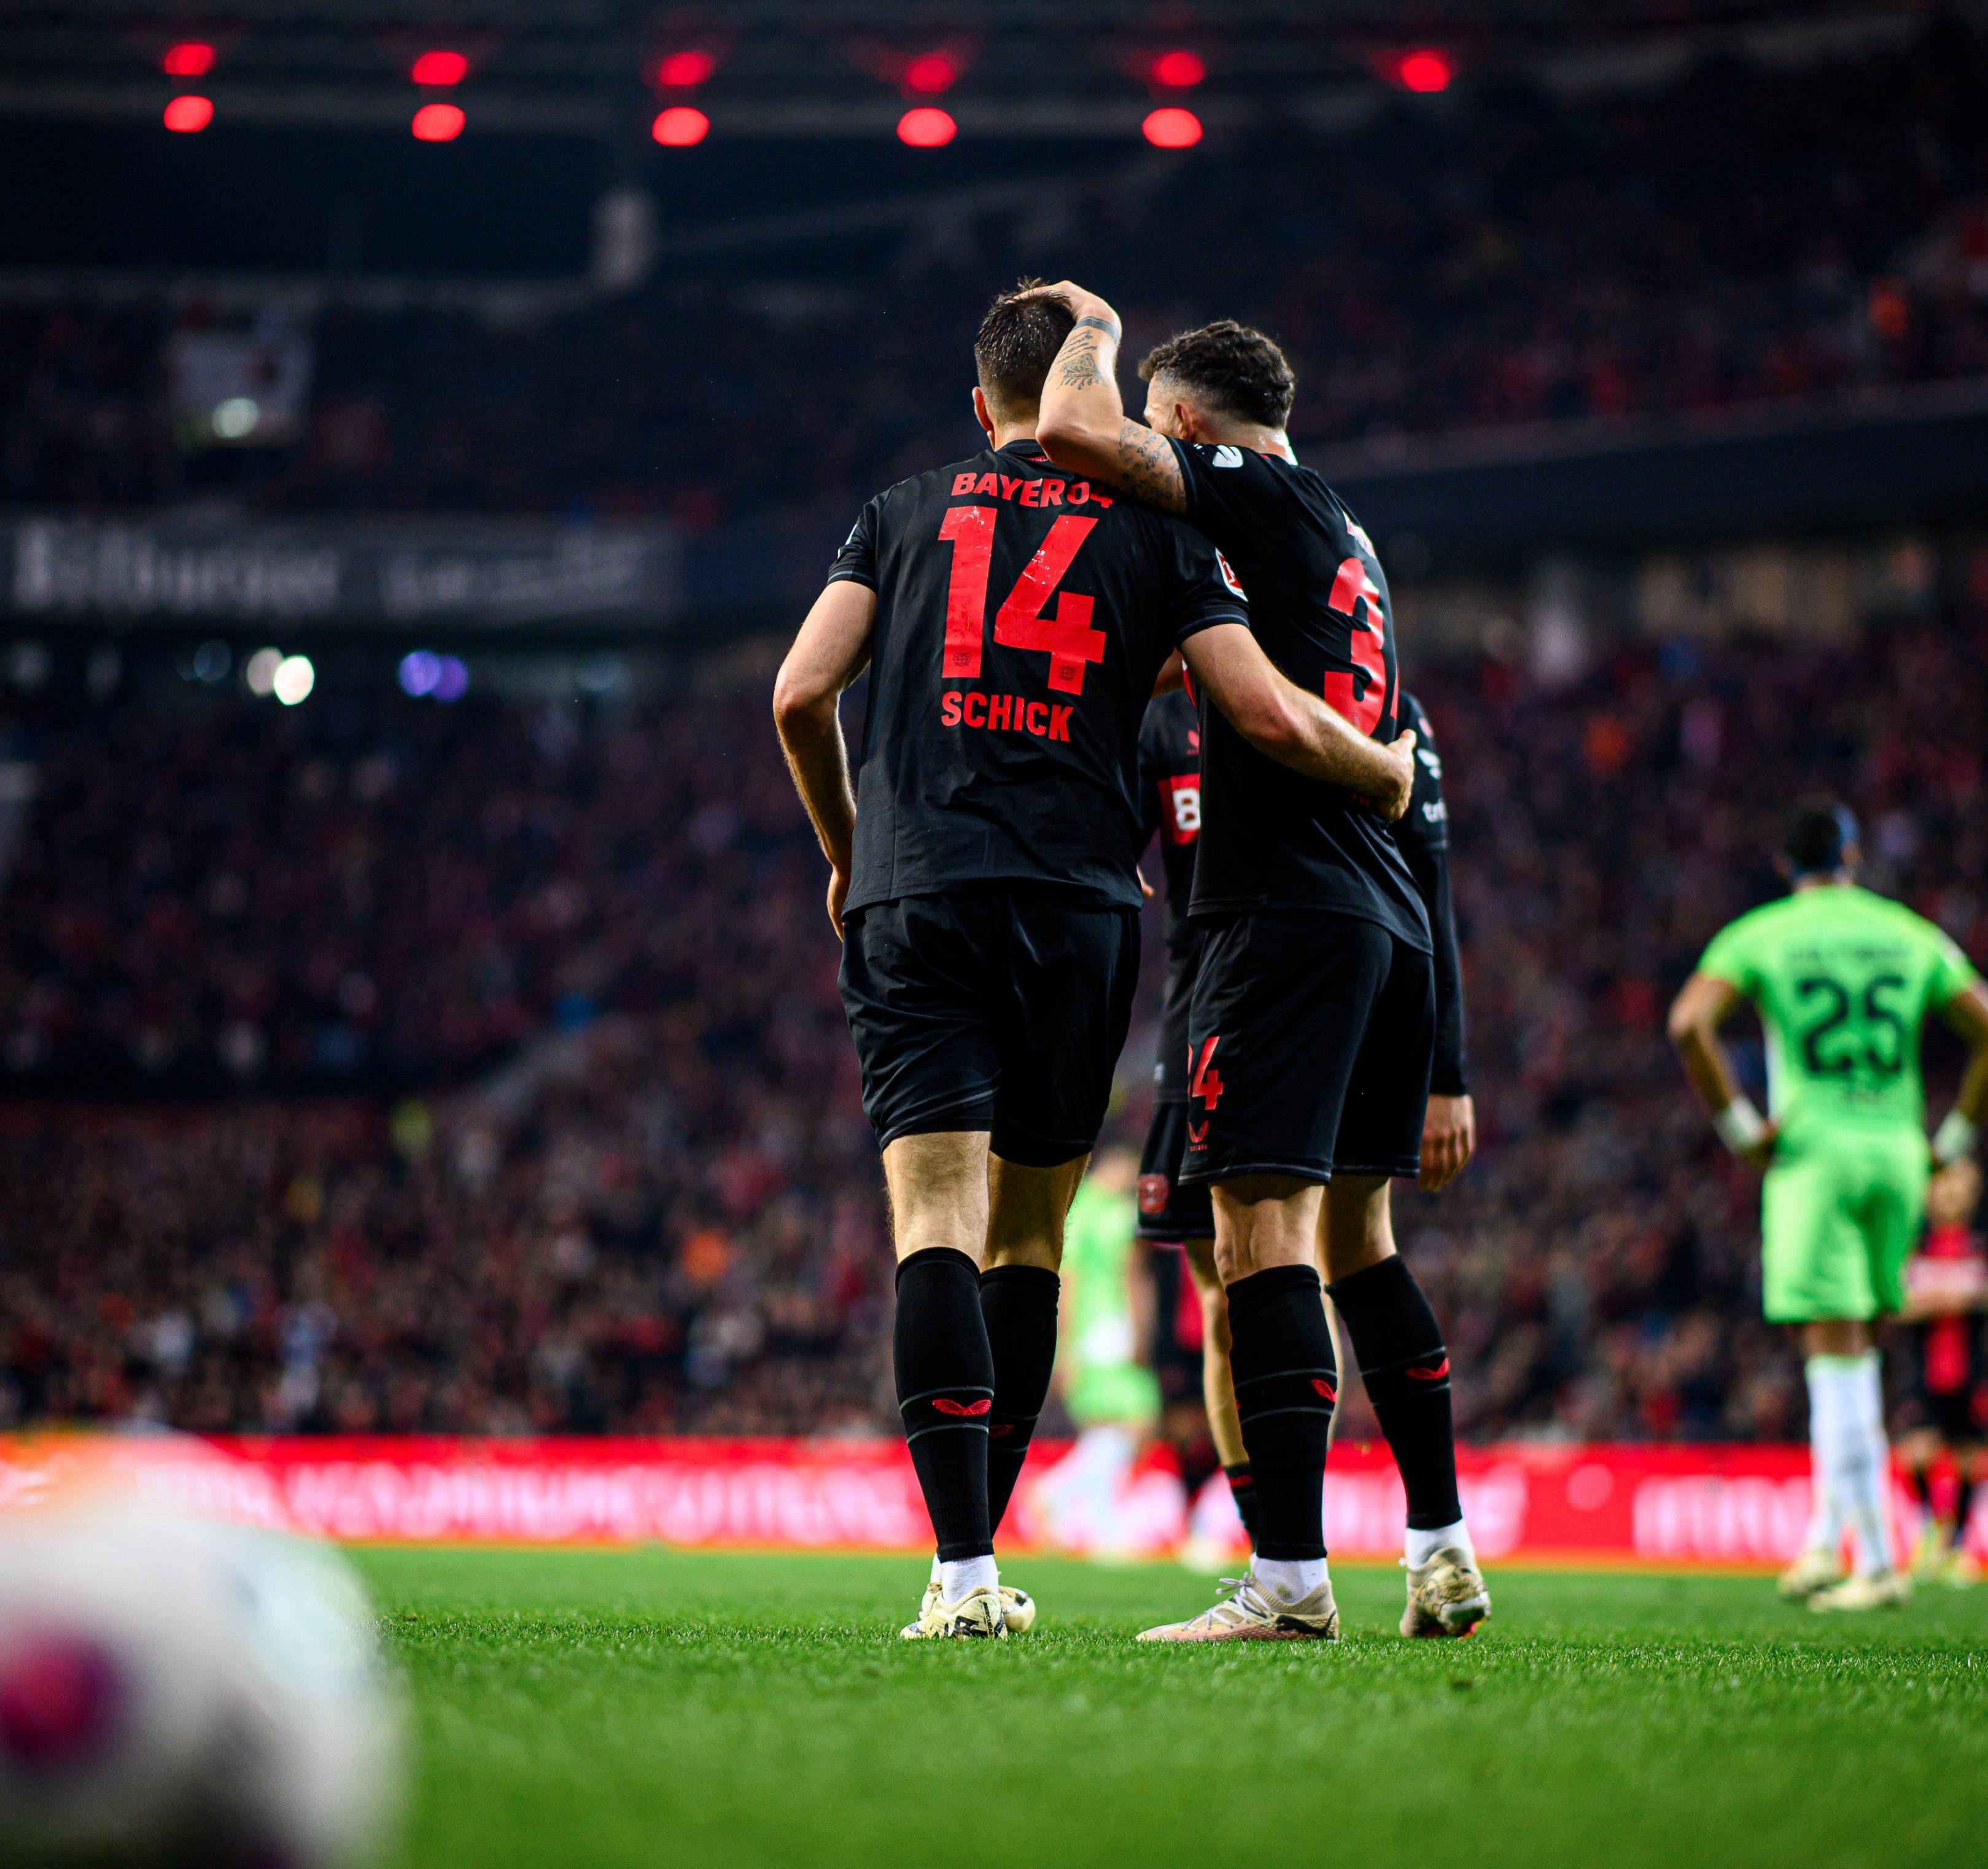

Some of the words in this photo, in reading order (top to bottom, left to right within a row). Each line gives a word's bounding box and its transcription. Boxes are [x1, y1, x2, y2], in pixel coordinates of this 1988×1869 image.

[951, 472, 1065, 507] BAYER
[938, 505, 1106, 696] 14
[1324, 557, 1399, 737] 3
[941, 690, 1074, 742] SCHICK
[1796, 974, 1906, 1079] 25
[1187, 1036, 1224, 1110] 4
